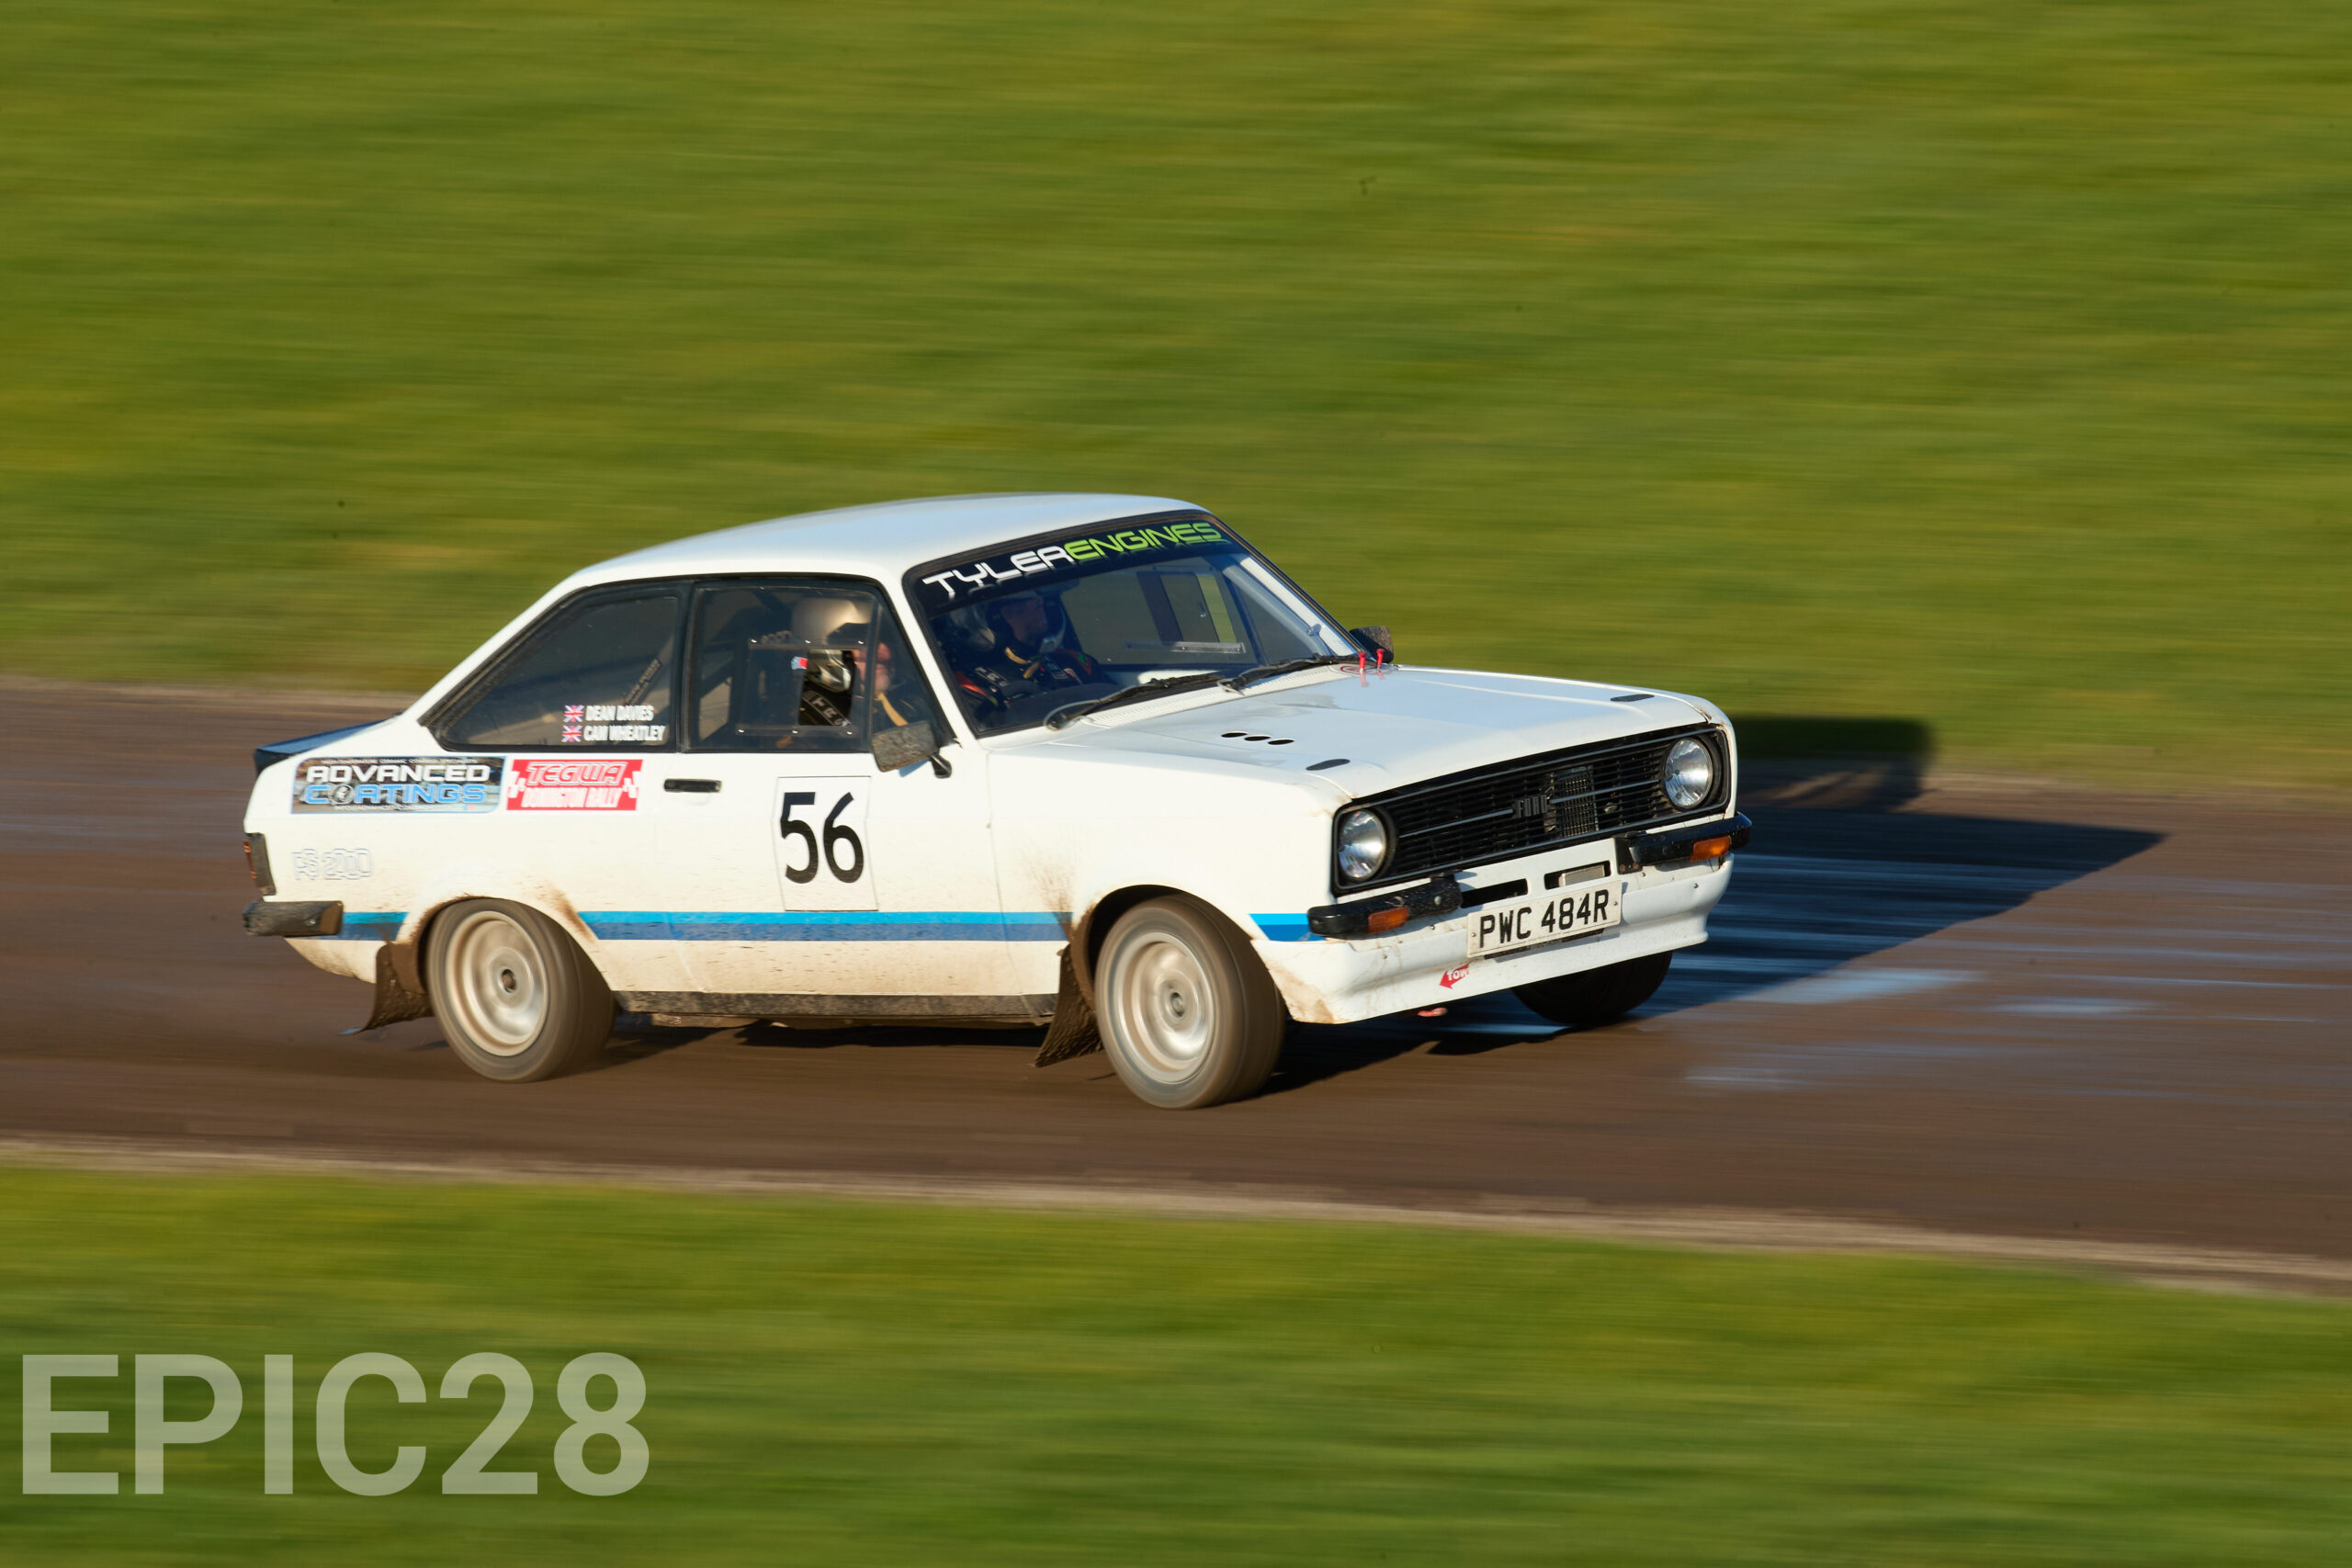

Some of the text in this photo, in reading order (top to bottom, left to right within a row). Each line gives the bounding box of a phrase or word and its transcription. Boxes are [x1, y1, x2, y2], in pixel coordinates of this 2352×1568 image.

[585, 705, 654, 721] DEAN DAVIES
[608, 725, 666, 741] WHEATLEY
[306, 764, 491, 783] ADVANCED
[585, 787, 624, 808] RALLY
[780, 792, 865, 884] 56
[1479, 888, 1609, 948] PWC 484R
